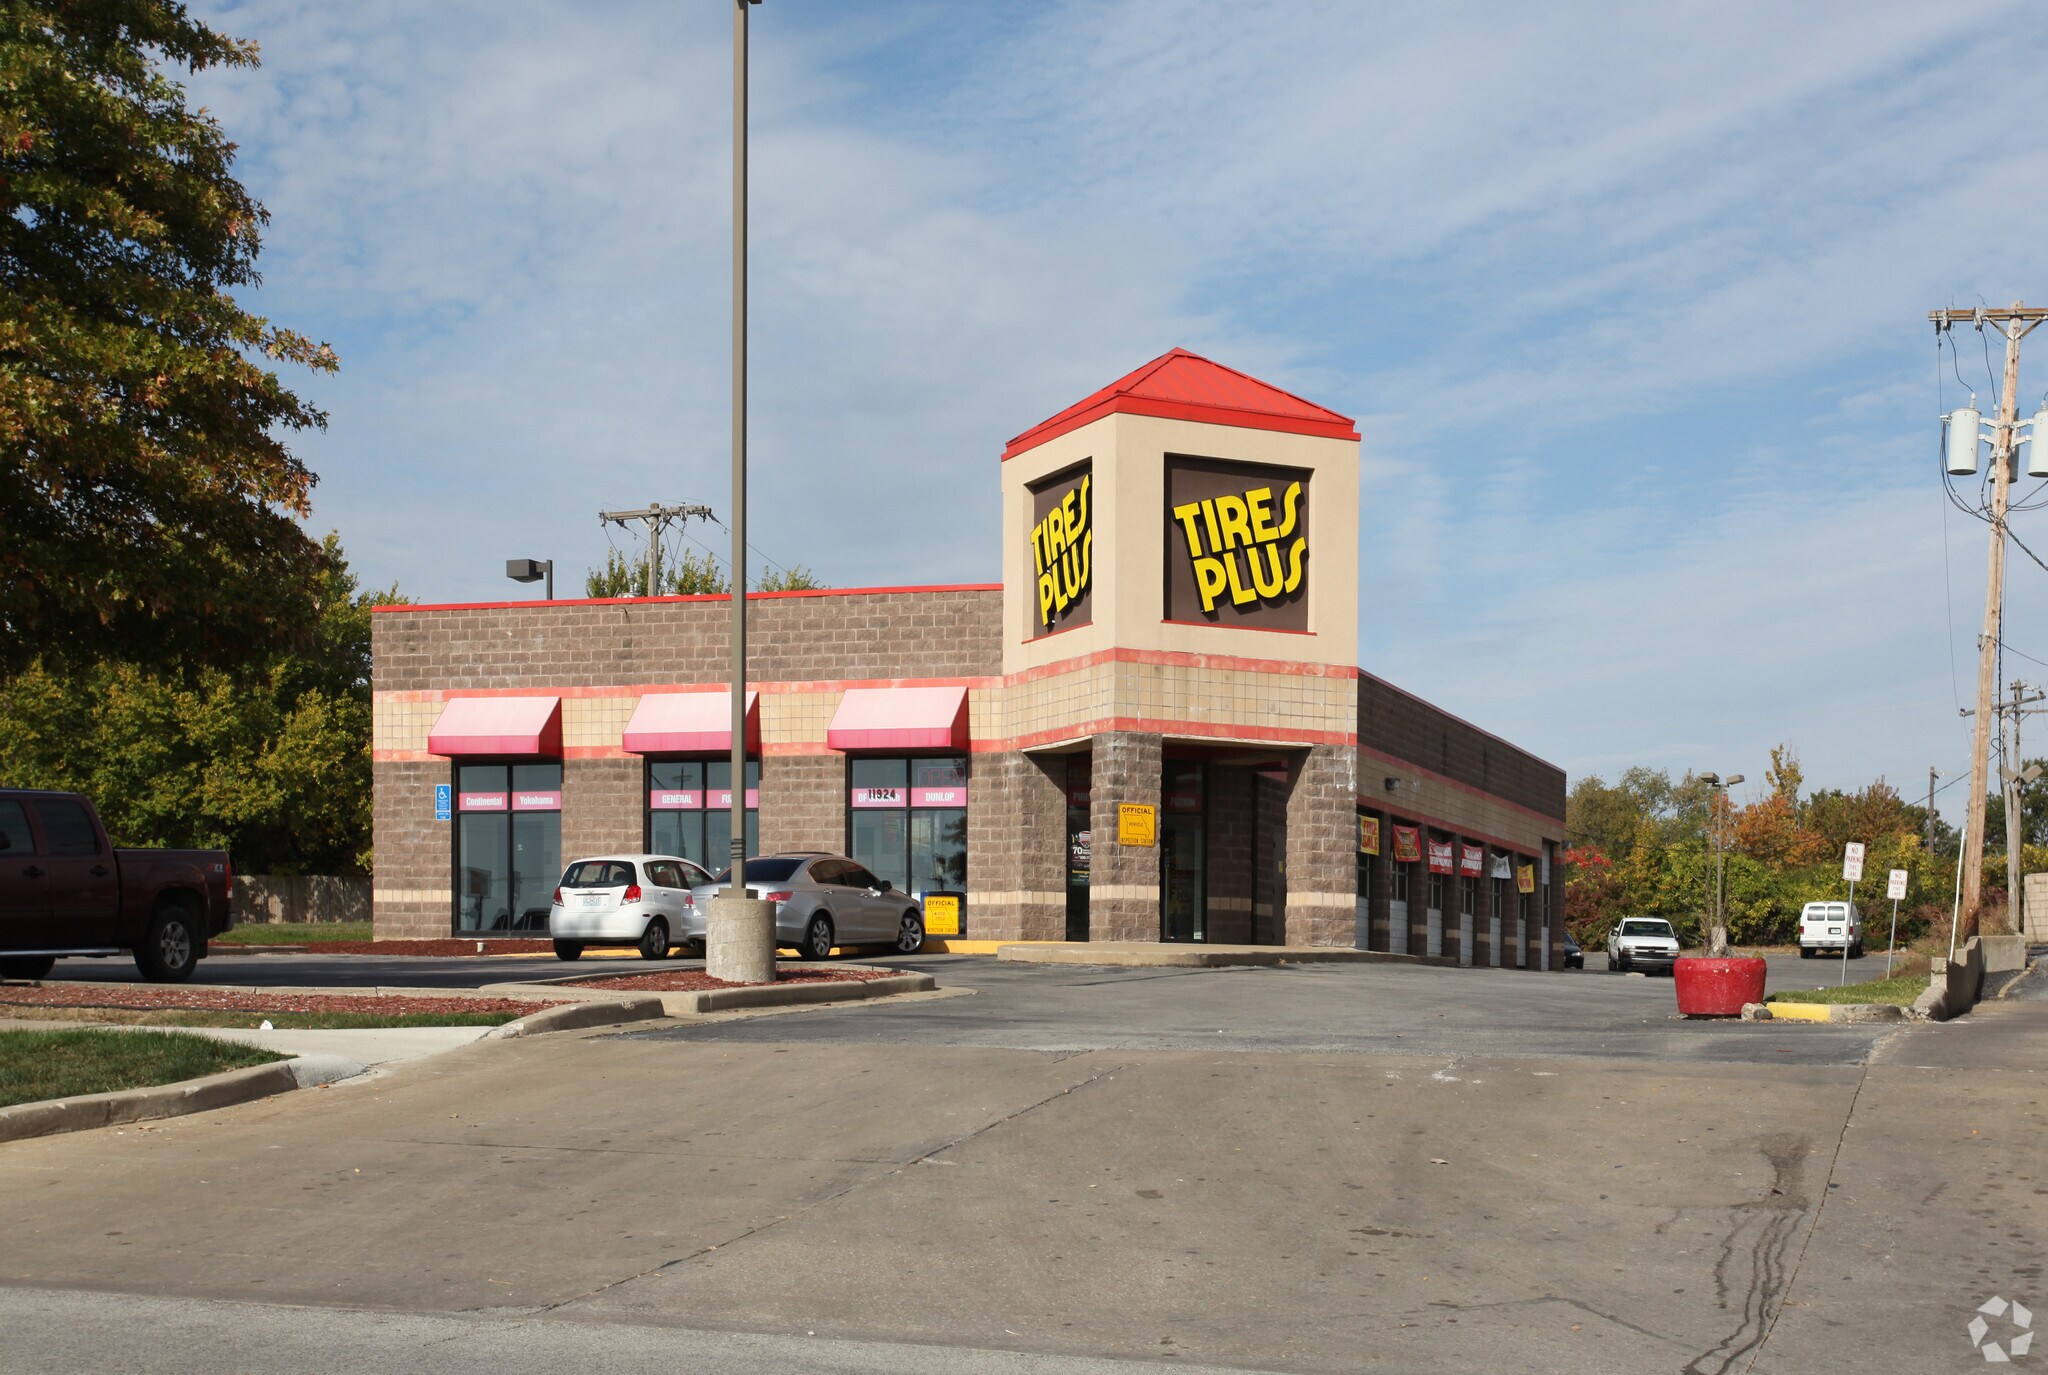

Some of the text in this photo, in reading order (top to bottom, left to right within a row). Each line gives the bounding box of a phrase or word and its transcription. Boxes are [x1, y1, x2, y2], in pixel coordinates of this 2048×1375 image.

[1030, 474, 1090, 574] TIRES
[1173, 481, 1301, 557] TIRES
[1038, 528, 1092, 626] PLUS
[1193, 537, 1306, 612] PLUS
[920, 768, 964, 787] OPEN
[466, 796, 502, 806] Continental
[520, 796, 553, 805] Yokohama
[662, 794, 692, 804] GENERAL
[868, 789, 896, 799] 11924
[925, 792, 954, 802] DUNLOP
